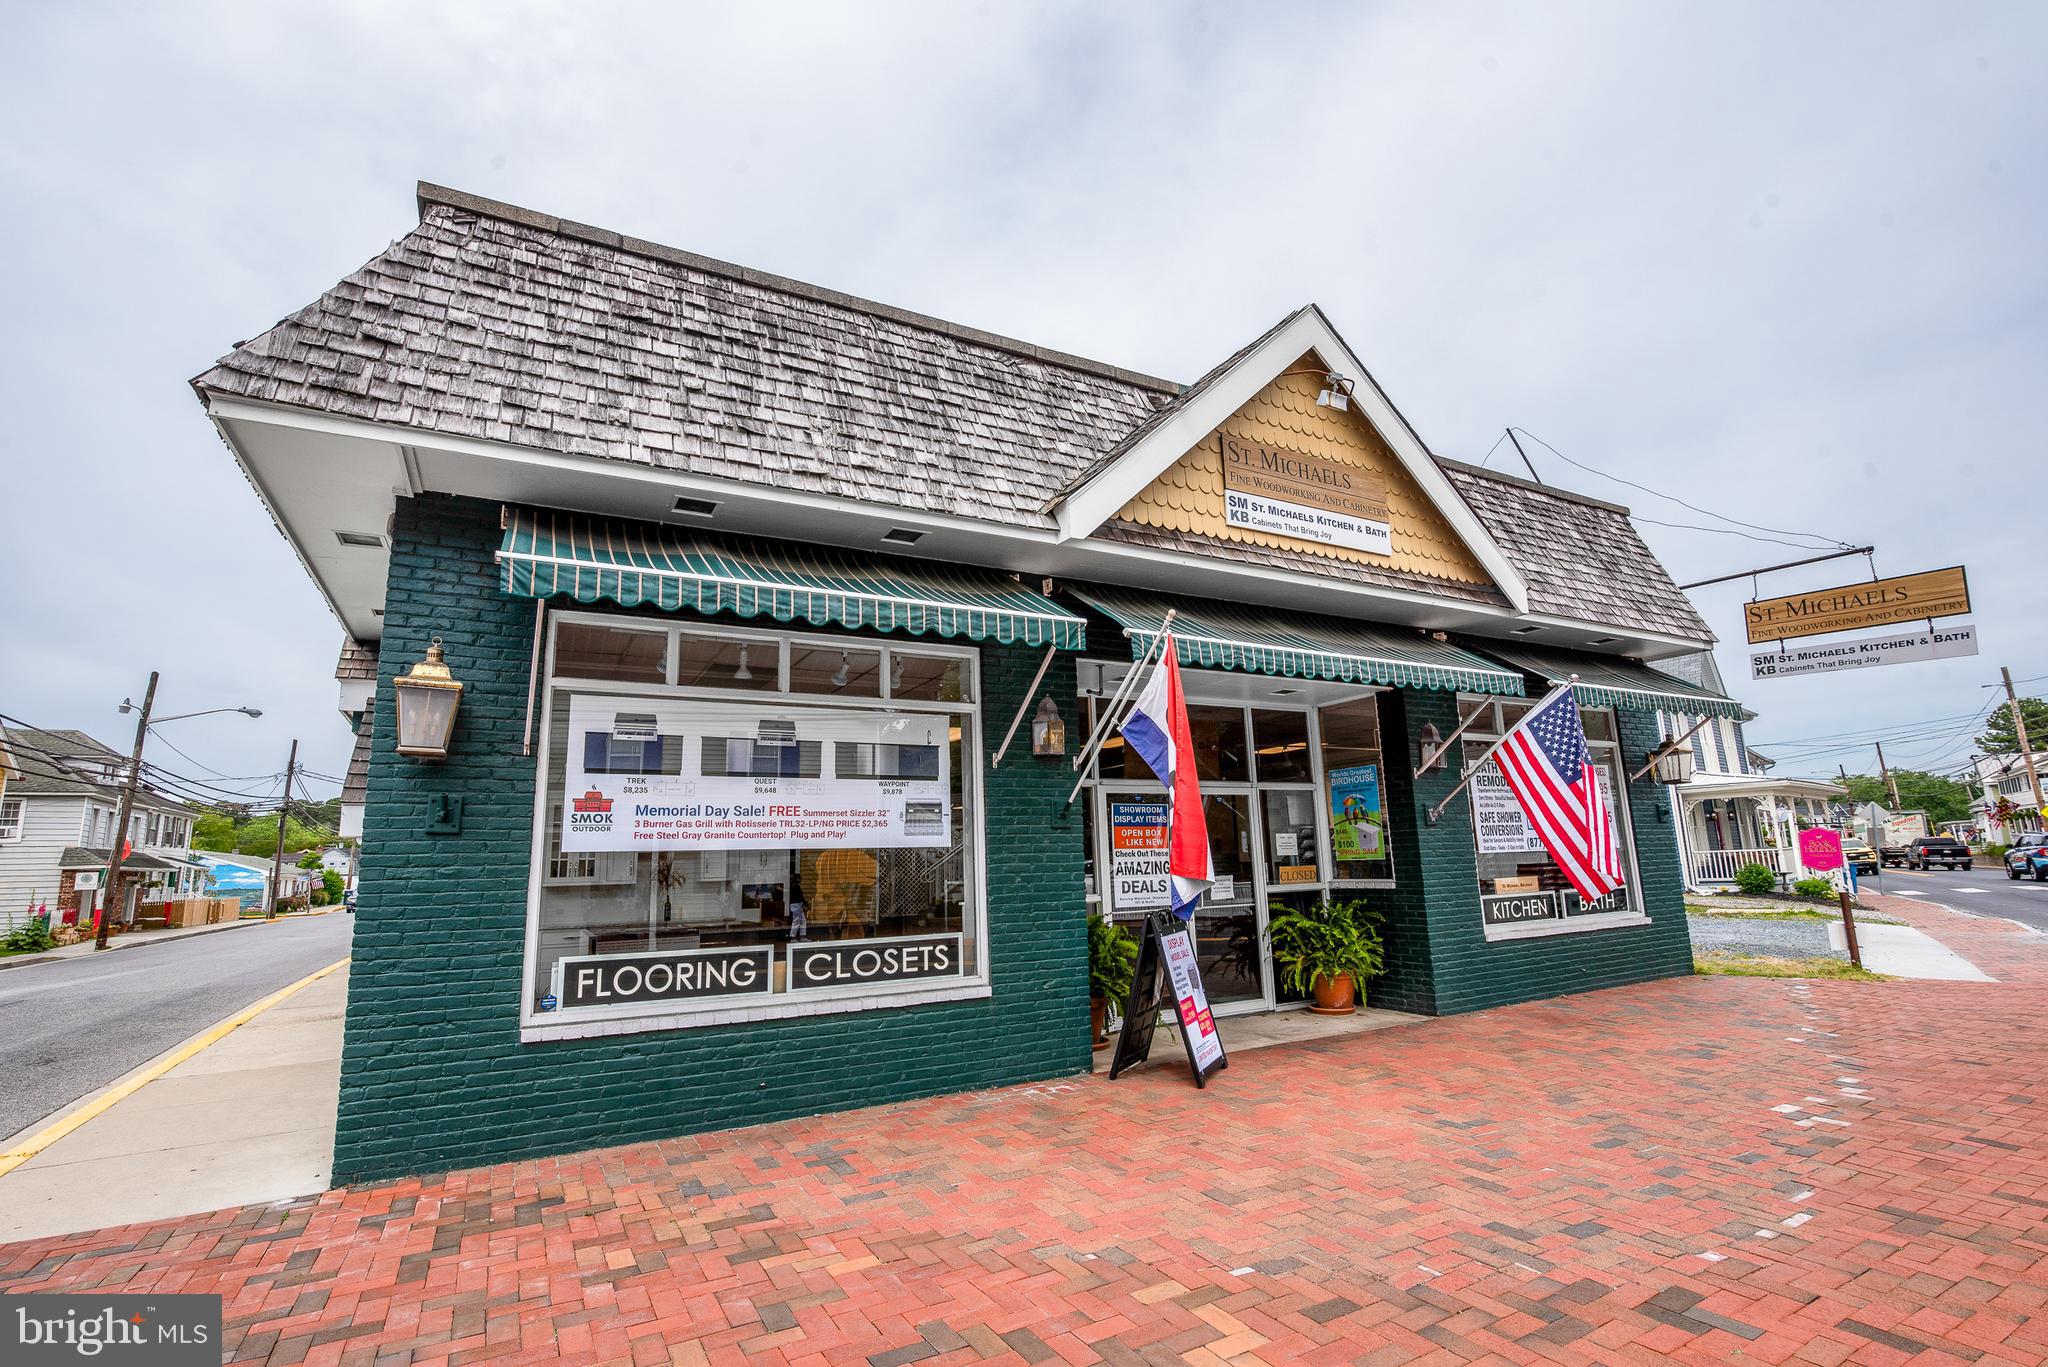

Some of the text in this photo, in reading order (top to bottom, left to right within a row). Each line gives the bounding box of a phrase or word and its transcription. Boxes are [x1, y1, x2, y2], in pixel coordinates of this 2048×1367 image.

[1227, 440, 1352, 490] ST. MICHAELS
[1229, 471, 1387, 517] FINE WOODWORKING AND CABINETRY
[1228, 495, 1387, 539] SM ST. MICHAELS KITCHEN & BATH
[1230, 509, 1333, 541] KB Cabinets That Bring Joy
[1749, 586, 1908, 624] ST. MICHAELS
[1751, 600, 1966, 639] FINE WOODWORKING AND CABINETRY
[1754, 631, 1970, 666] SM ST. MICHAELS KITCHEN & BATH
[1755, 655, 1881, 676] KB Cabinets That Bring Joy
[1477, 763, 1498, 774] ATH
[626, 777, 647, 785] TREK
[1331, 774, 1375, 786] BIRDHOUSE
[1476, 775, 1509, 787] REMOD
[623, 786, 649, 794] $8,235
[754, 786, 777, 794] $9,648
[635, 804, 700, 817] Memorial
[704, 805, 730, 819] Day
[733, 805, 765, 817] Sale!
[768, 805, 801, 817] FREE
[849, 809, 876, 817] Sizzler
[1119, 806, 1163, 814] SHOWROOM
[570, 813, 613, 824] SMOK
[1114, 815, 1167, 823] DISPLAY ITEMS
[1479, 811, 1522, 824] SAFE SHOWER
[634, 820, 888, 828] 3 Burner Gas Grill with Rotisserie TRL32-LP/NG PRICE $2,365
[633, 831, 654, 839] Free
[656, 831, 680, 839] Steel
[681, 831, 702, 841] Gray
[703, 831, 736, 839] Granite
[737, 831, 787, 840] Countertop!
[790, 831, 809, 840] Plug
[827, 830, 847, 840] Play!
[1121, 829, 1162, 837] OPEN BOX
[1481, 824, 1524, 837] CONVERSIONS
[1126, 838, 1144, 846] LIKE
[1146, 838, 1163, 846] NEW
[1338, 840, 1354, 849] $100
[1337, 847, 1379, 856] SPRING SALE
[1115, 861, 1170, 876] AMAZING
[1280, 870, 1316, 881] CLOSED
[1121, 880, 1167, 894] DEALS
[1492, 899, 1548, 919] KITCHEN
[804, 944, 949, 981] CLOSETS
[576, 957, 758, 999] FLOORING
